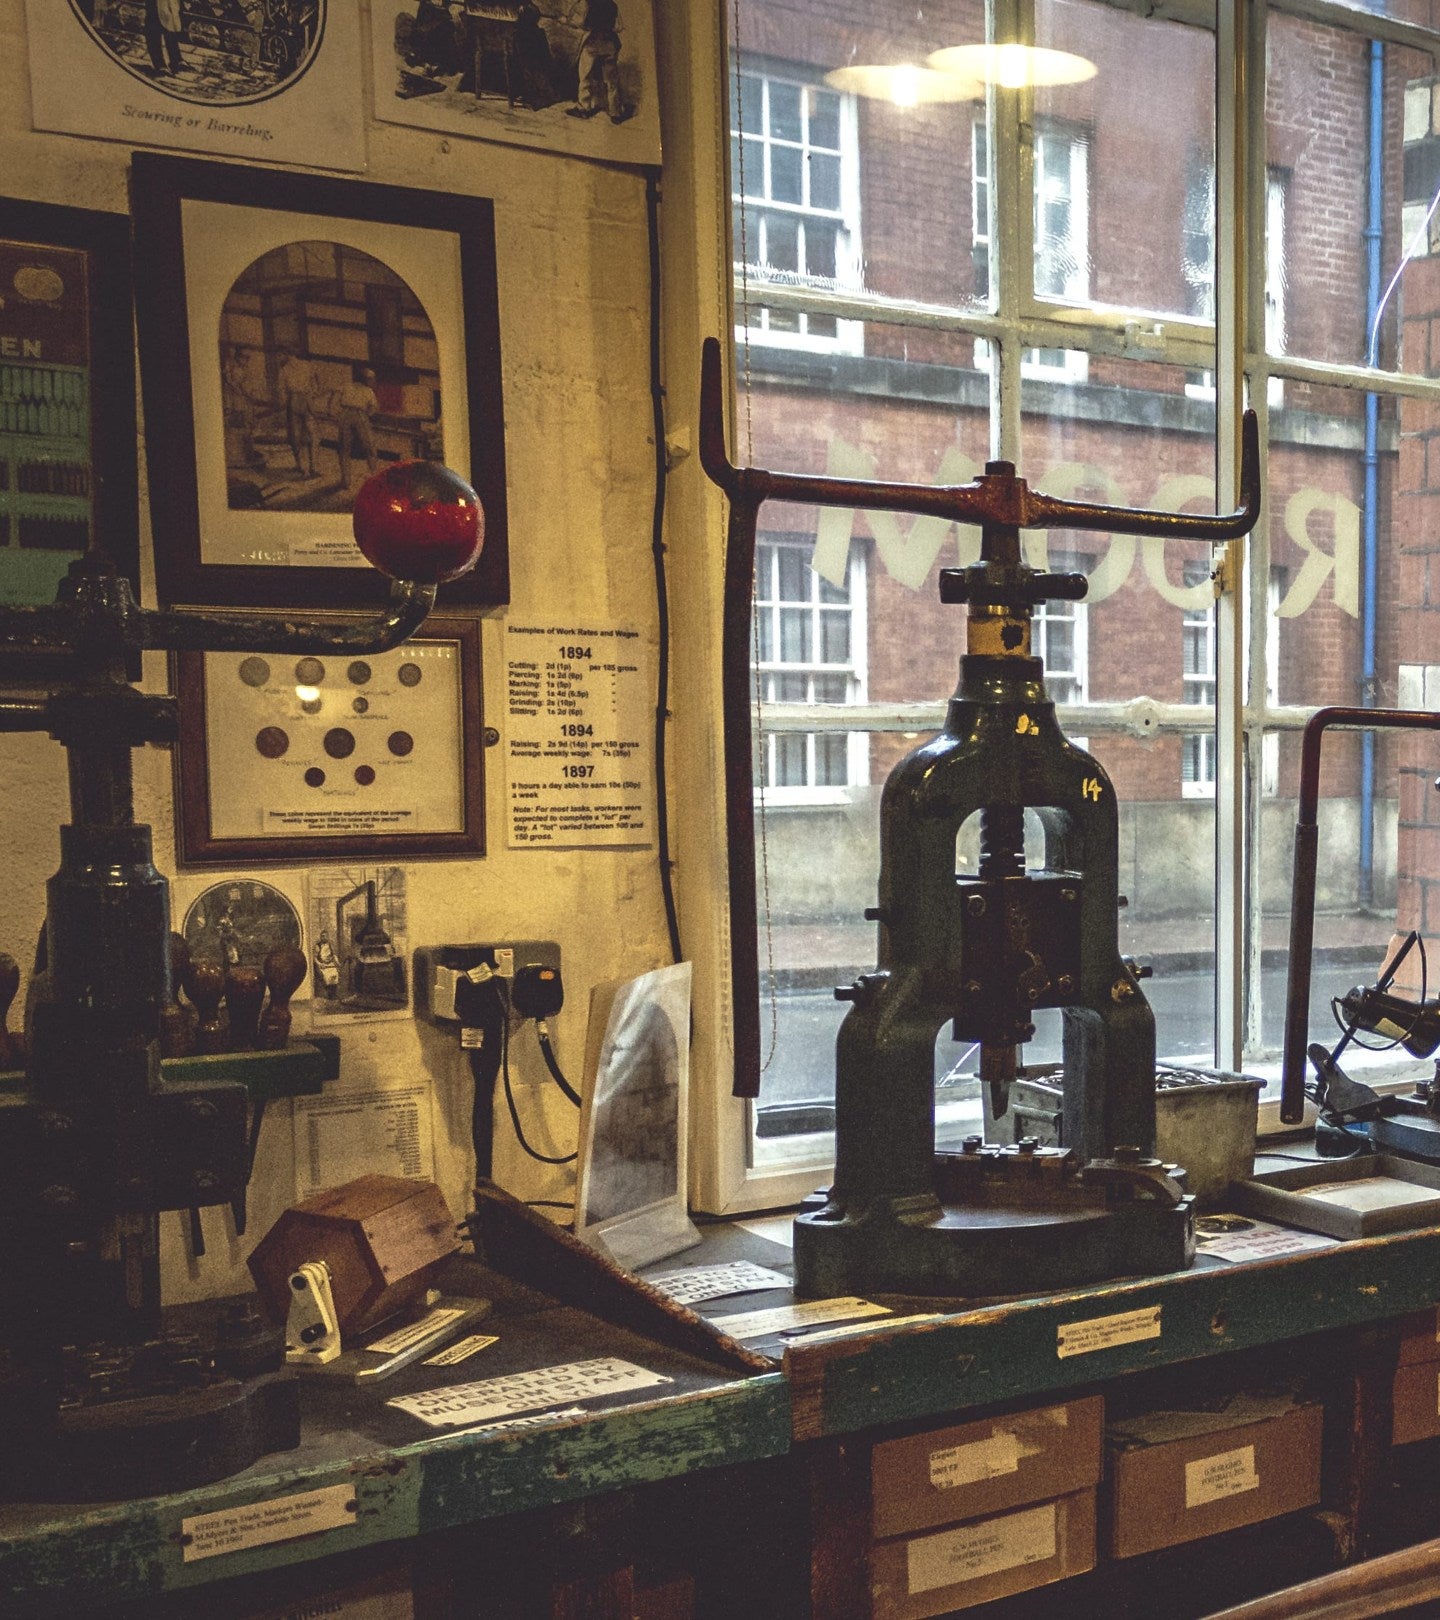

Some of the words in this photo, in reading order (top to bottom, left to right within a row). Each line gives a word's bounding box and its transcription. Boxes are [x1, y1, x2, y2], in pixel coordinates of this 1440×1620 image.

[121, 104, 183, 128] Scouring
[186, 119, 200, 127] or
[508, 626, 545, 636] Examples
[547, 627, 555, 635] of
[556, 628, 576, 636] Work
[577, 629, 598, 637] Rates
[600, 629, 614, 637] and
[615, 630, 639, 639] Wages
[559, 646, 592, 659] 1894
[589, 664, 601, 672] per
[617, 665, 638, 673] gross
[508, 671, 542, 680] Piercing:
[508, 680, 541, 689] Marking:
[509, 689, 540, 698] Raising:
[560, 724, 594, 737] 1894
[510, 740, 541, 749] Raising:
[591, 741, 603, 749] per
[619, 741, 640, 749] gross
[511, 750, 541, 758] Average
[543, 750, 569, 758] weekly
[562, 765, 595, 778] 1897
[518, 782, 540, 790] hours
[548, 782, 562, 791] day
[1082, 777, 1102, 802] 14
[518, 791, 539, 799] week
[513, 805, 533, 813] Note:
[535, 805, 549, 813] For
[594, 804, 622, 812] workers
[513, 814, 548, 823] expected
[549, 814, 557, 822] to
[559, 814, 593, 823] complete
[619, 814, 632, 822] per
[559, 823, 583, 831] varied
[583, 822, 614, 830] between
[416, 1374, 573, 1408] OPERATED
[579, 1364, 615, 1378] BY
[419, 1388, 549, 1418] MUSEUM
[554, 1369, 641, 1391] STAFF
